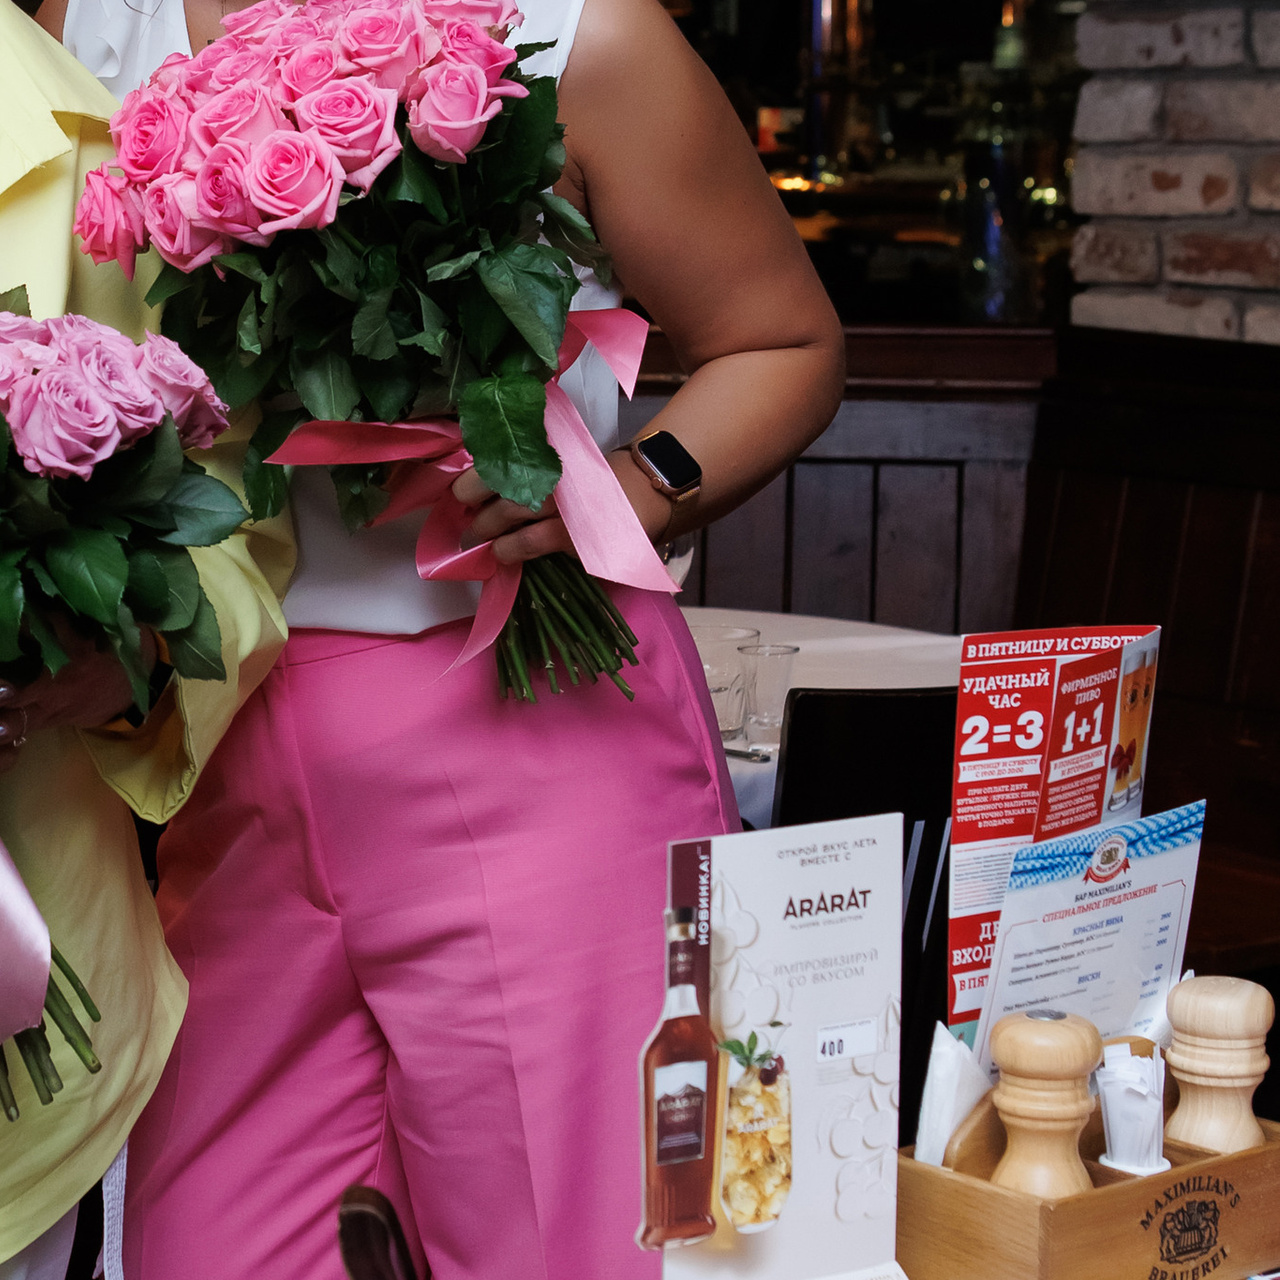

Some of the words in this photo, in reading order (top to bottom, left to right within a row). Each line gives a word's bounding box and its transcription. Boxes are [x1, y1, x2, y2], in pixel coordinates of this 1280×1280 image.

[967, 645, 977, 658] В
[978, 639, 1055, 657] ПЯТНИЦУ
[1056, 638, 1069, 651] И
[963, 668, 1050, 694] УДАЧНЫЙ
[1061, 668, 1118, 695] ФИРМЕННОЕ
[988, 693, 1021, 709] ЧАС
[1075, 688, 1101, 705] ПИВО
[960, 710, 1044, 756] 2=3
[1061, 702, 1103, 753] 1+1
[777, 846, 818, 859] ОТКРОЙ
[822, 841, 849, 853] ВКУС
[853, 838, 878, 850] ЛЕТА
[799, 855, 835, 867] ВМЕСТЕ
[840, 852, 852, 862] С
[697, 854, 711, 946] НОВИНКА!
[1074, 894, 1088, 903] БАР
[1089, 880, 1132, 899] MAXIMILIAN'S
[1042, 900, 1101, 923] СПЕЦИАЛЬНОЕ
[1102, 884, 1158, 908] ПРЕДЛОЖЕНИЕ
[1072, 920, 1104, 936] КРАСНЫЕ
[1105, 916, 1123, 927] ВИНА
[773, 948, 879, 977] ИМПРОВИЗИРУЙ
[788, 975, 807, 988] СО
[812, 966, 865, 984] ВКУСОМ
[1077, 971, 1101, 985] ВИСКИ
[820, 1039, 844, 1056] 400
[1140, 1175, 1241, 1231] MAXIMILIAN'S
